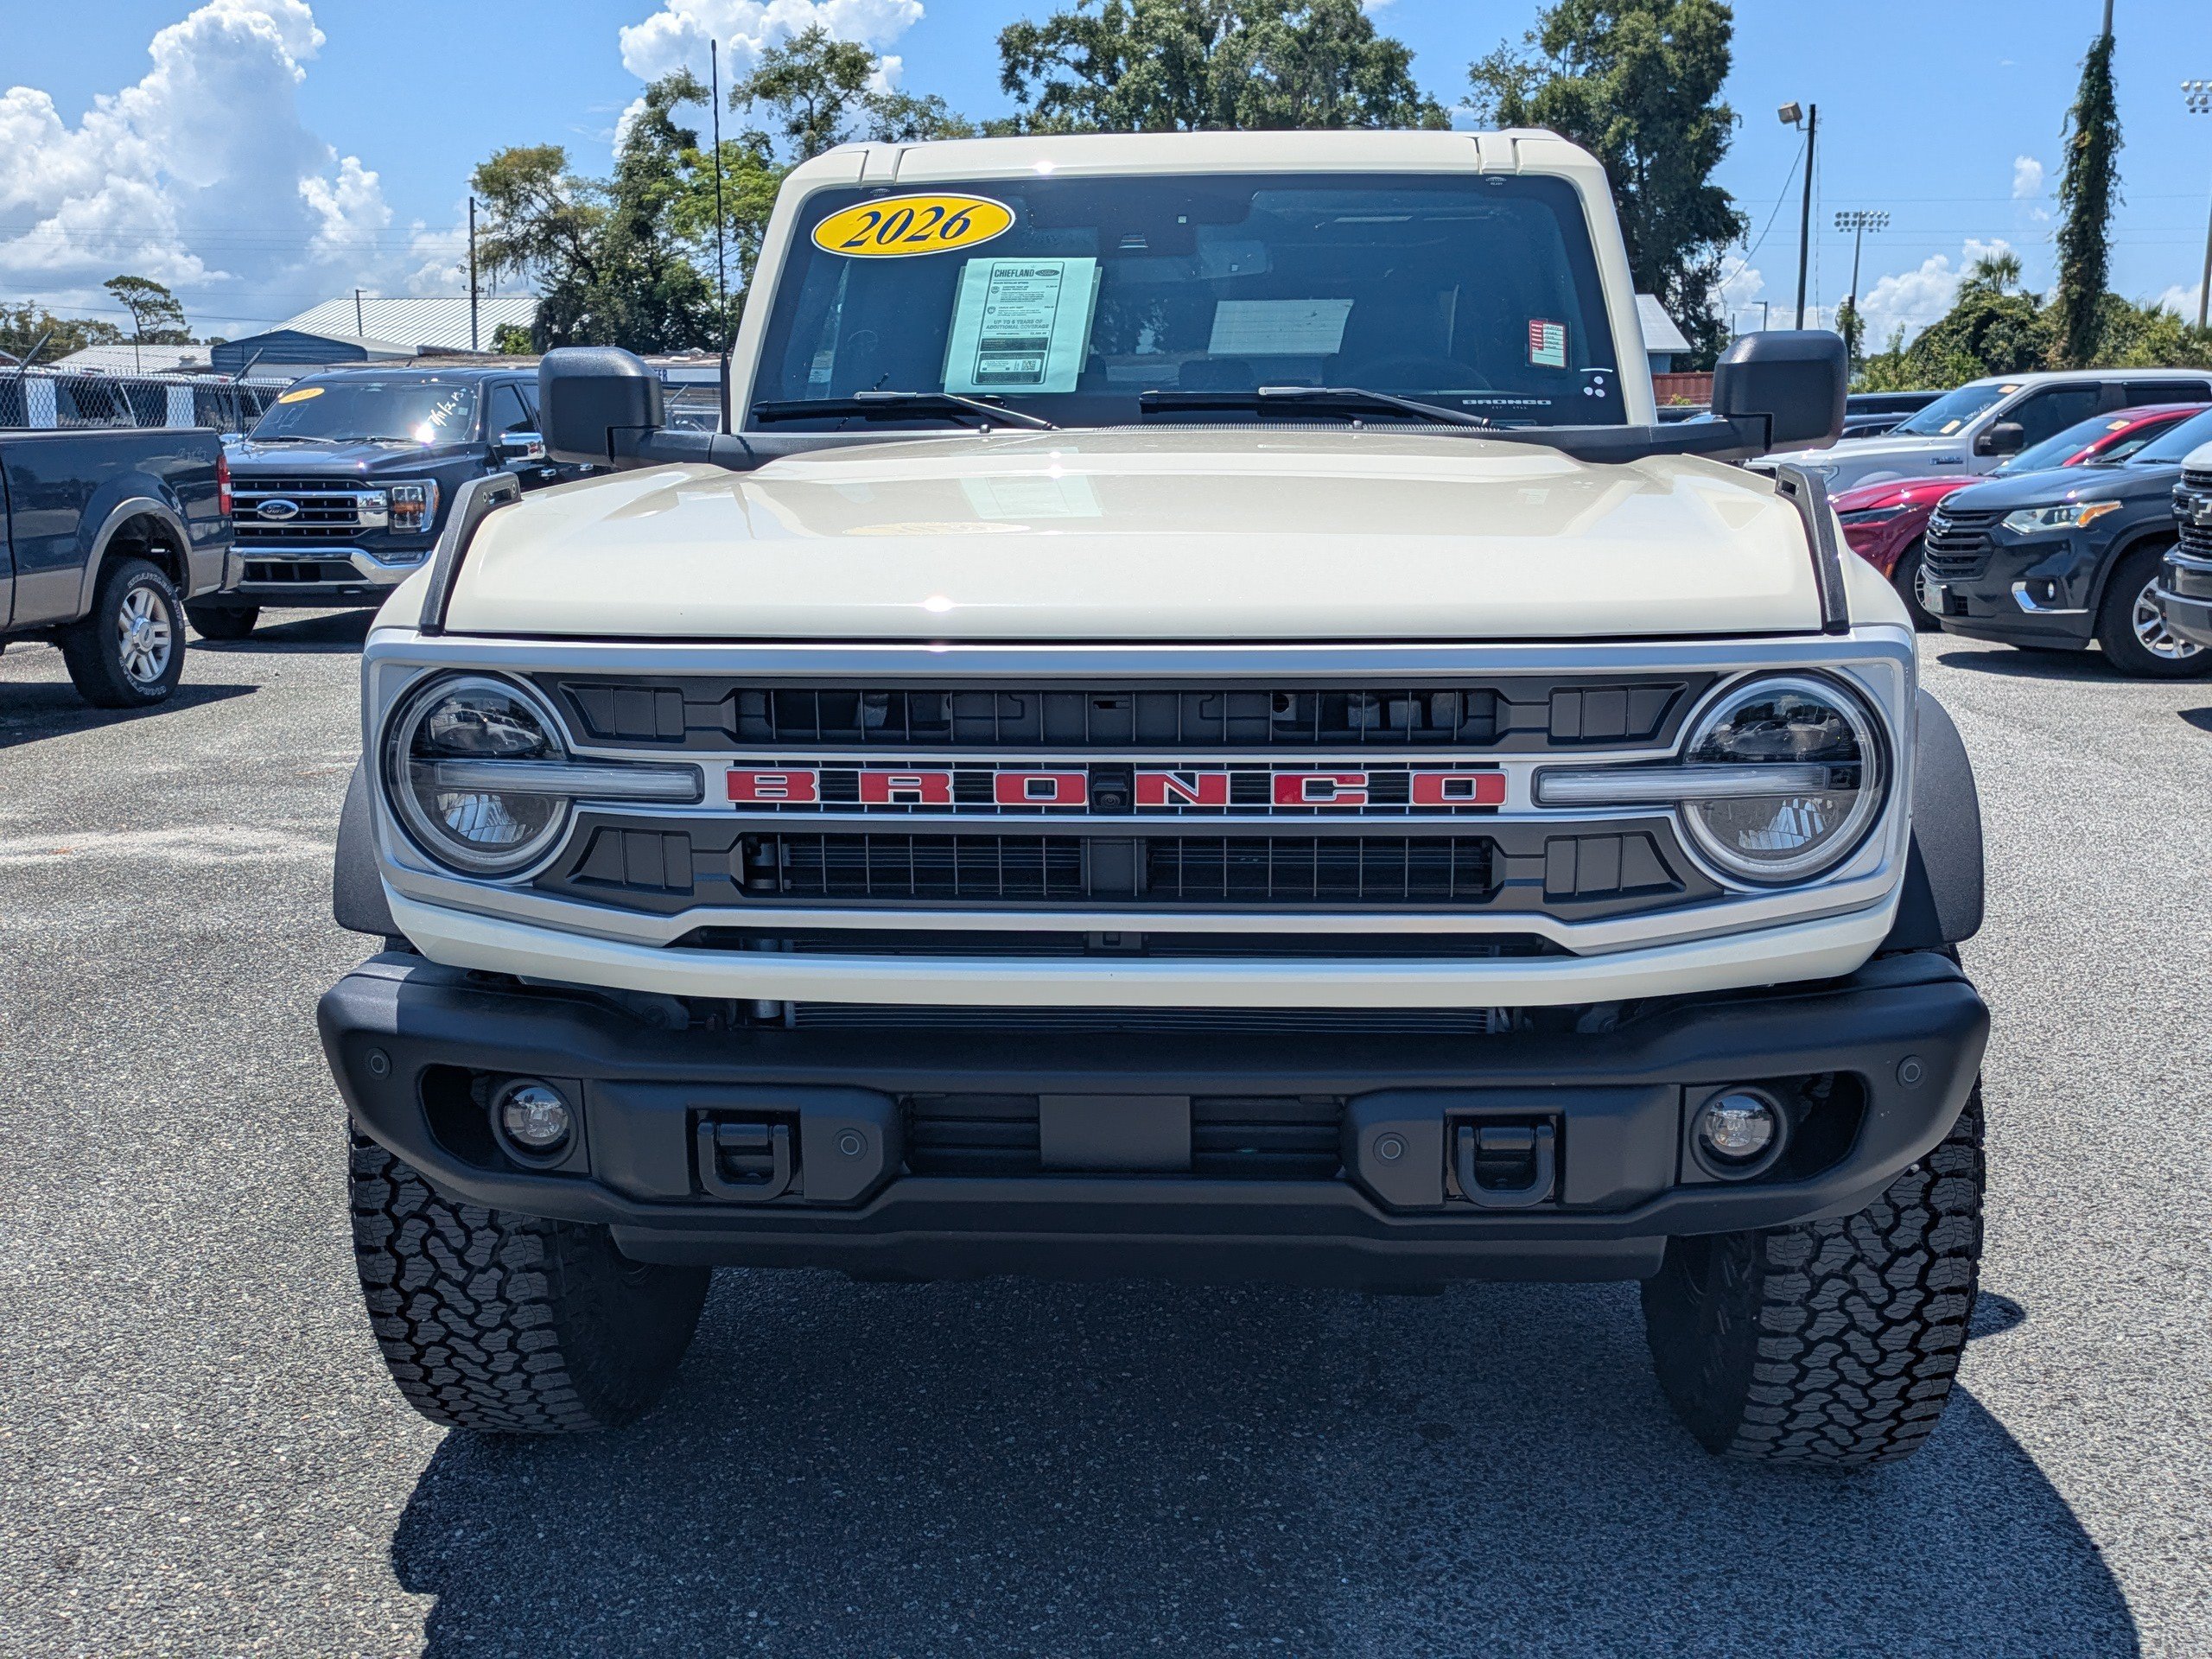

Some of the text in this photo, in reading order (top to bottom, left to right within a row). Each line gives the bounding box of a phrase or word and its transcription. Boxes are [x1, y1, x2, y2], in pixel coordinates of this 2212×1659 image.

[839, 204, 983, 248] 2026
[995, 269, 1035, 277] CHIEFLAND
[725, 766, 1508, 807] BRONCO
